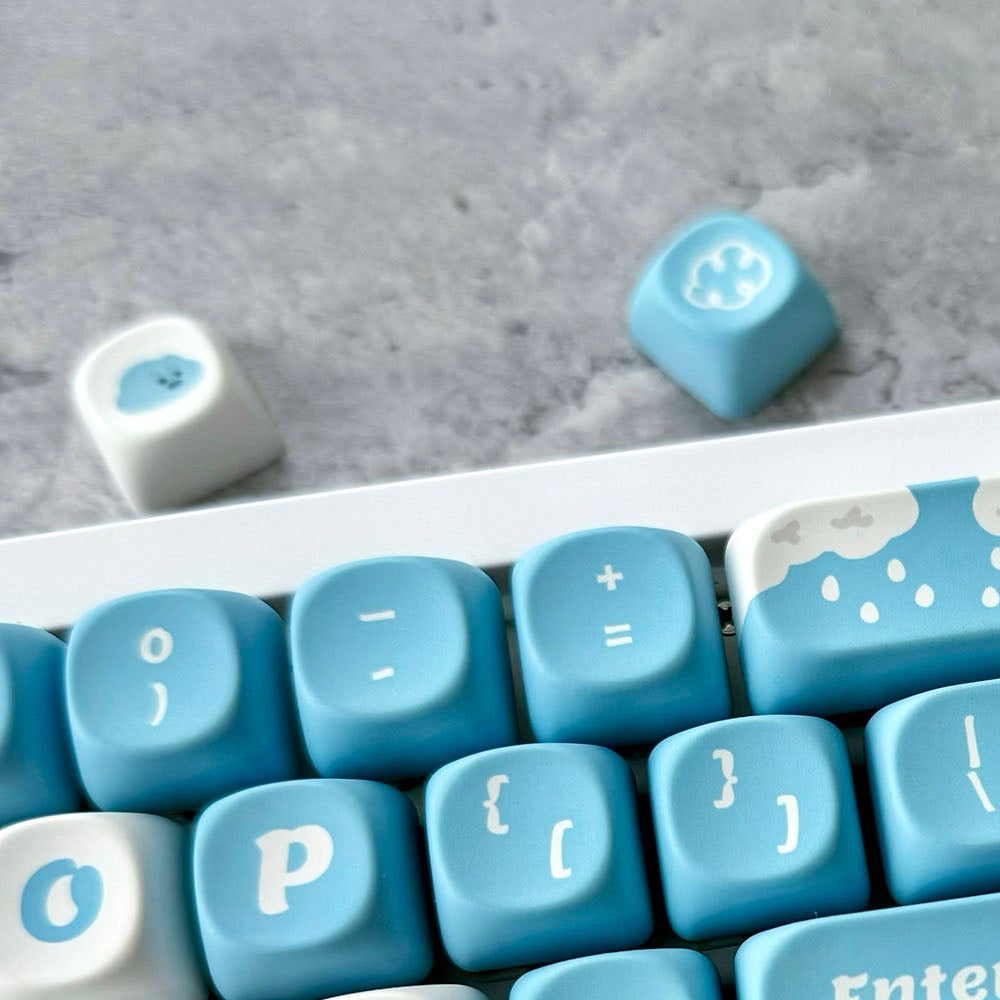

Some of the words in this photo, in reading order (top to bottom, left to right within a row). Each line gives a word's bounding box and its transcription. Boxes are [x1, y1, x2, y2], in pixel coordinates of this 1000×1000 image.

[149, 682, 168, 727] )
[482, 773, 510, 835] {
[711, 748, 738, 810] }
[549, 818, 573, 880] [
[776, 793, 799, 855] ]
[19, 858, 104, 943] O
[255, 824, 334, 915] P
